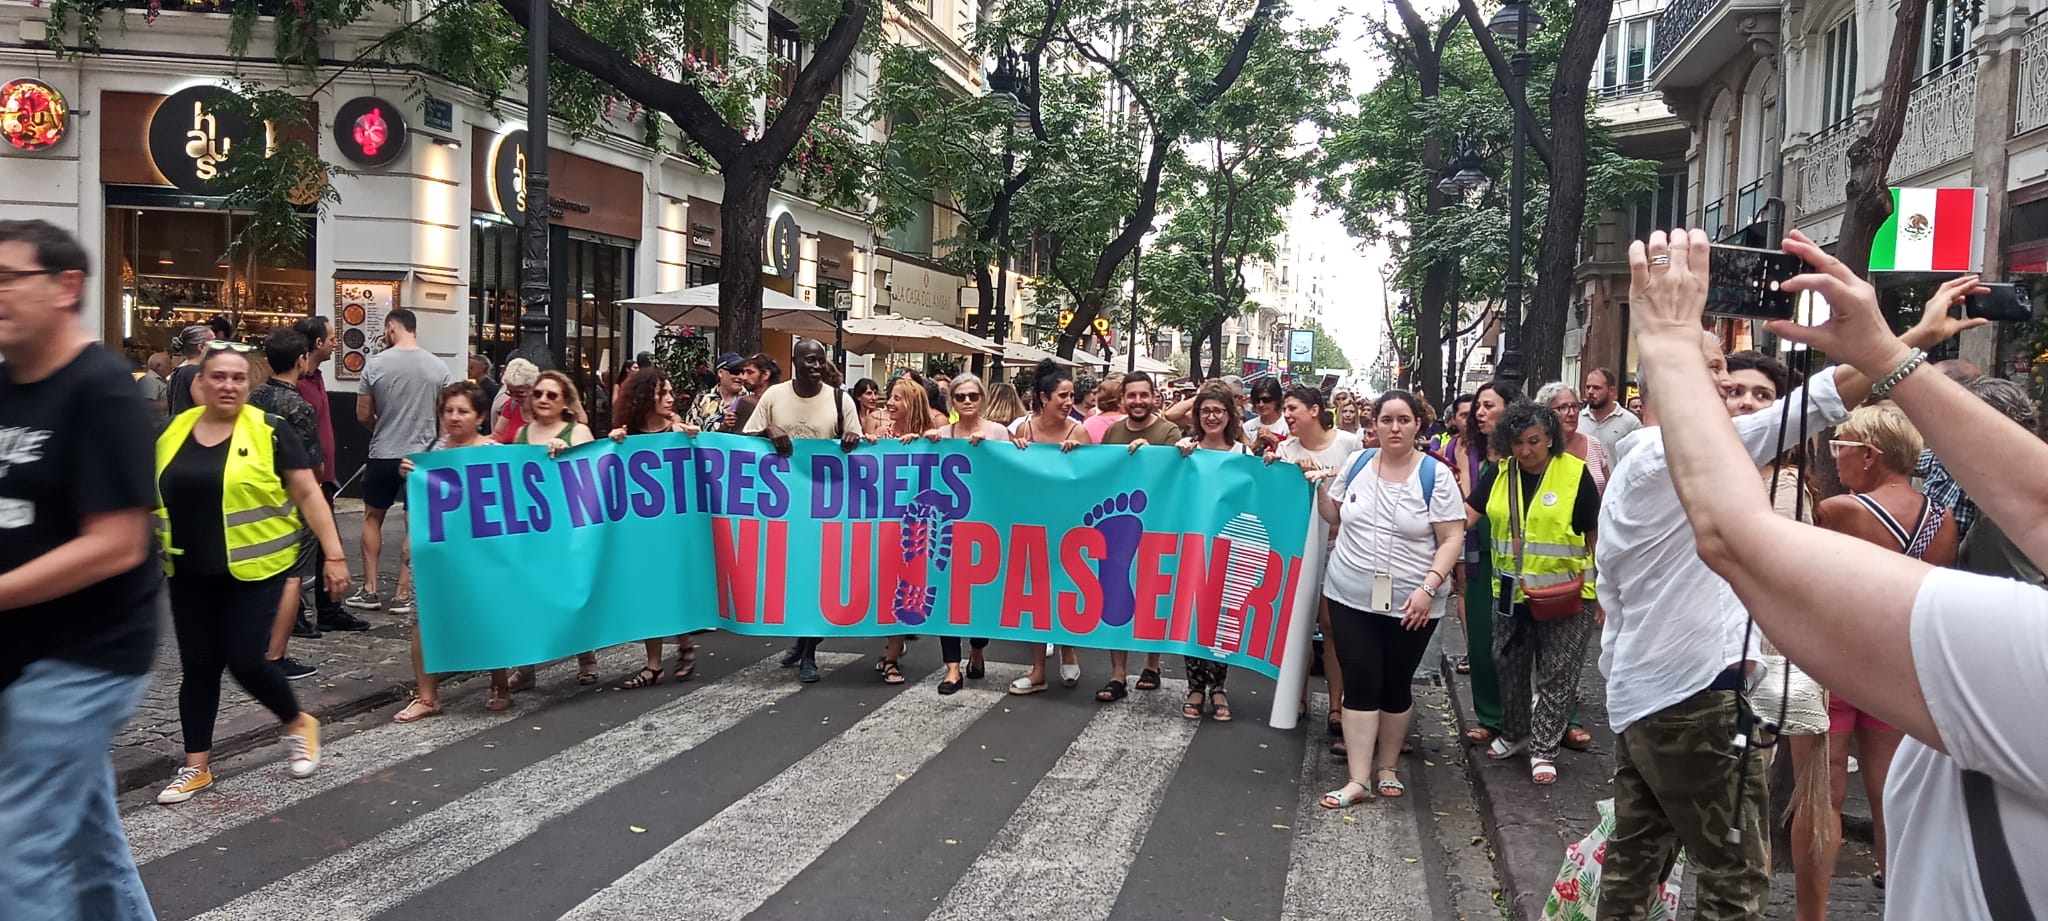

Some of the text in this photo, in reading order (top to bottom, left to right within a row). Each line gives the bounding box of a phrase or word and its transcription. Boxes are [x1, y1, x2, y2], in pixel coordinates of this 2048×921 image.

[185, 100, 231, 180] haus
[427, 447, 972, 543] PELS NOSTRES DRETS
[712, 516, 788, 625] NI
[819, 520, 928, 626] UN
[948, 521, 1107, 635] PAS
